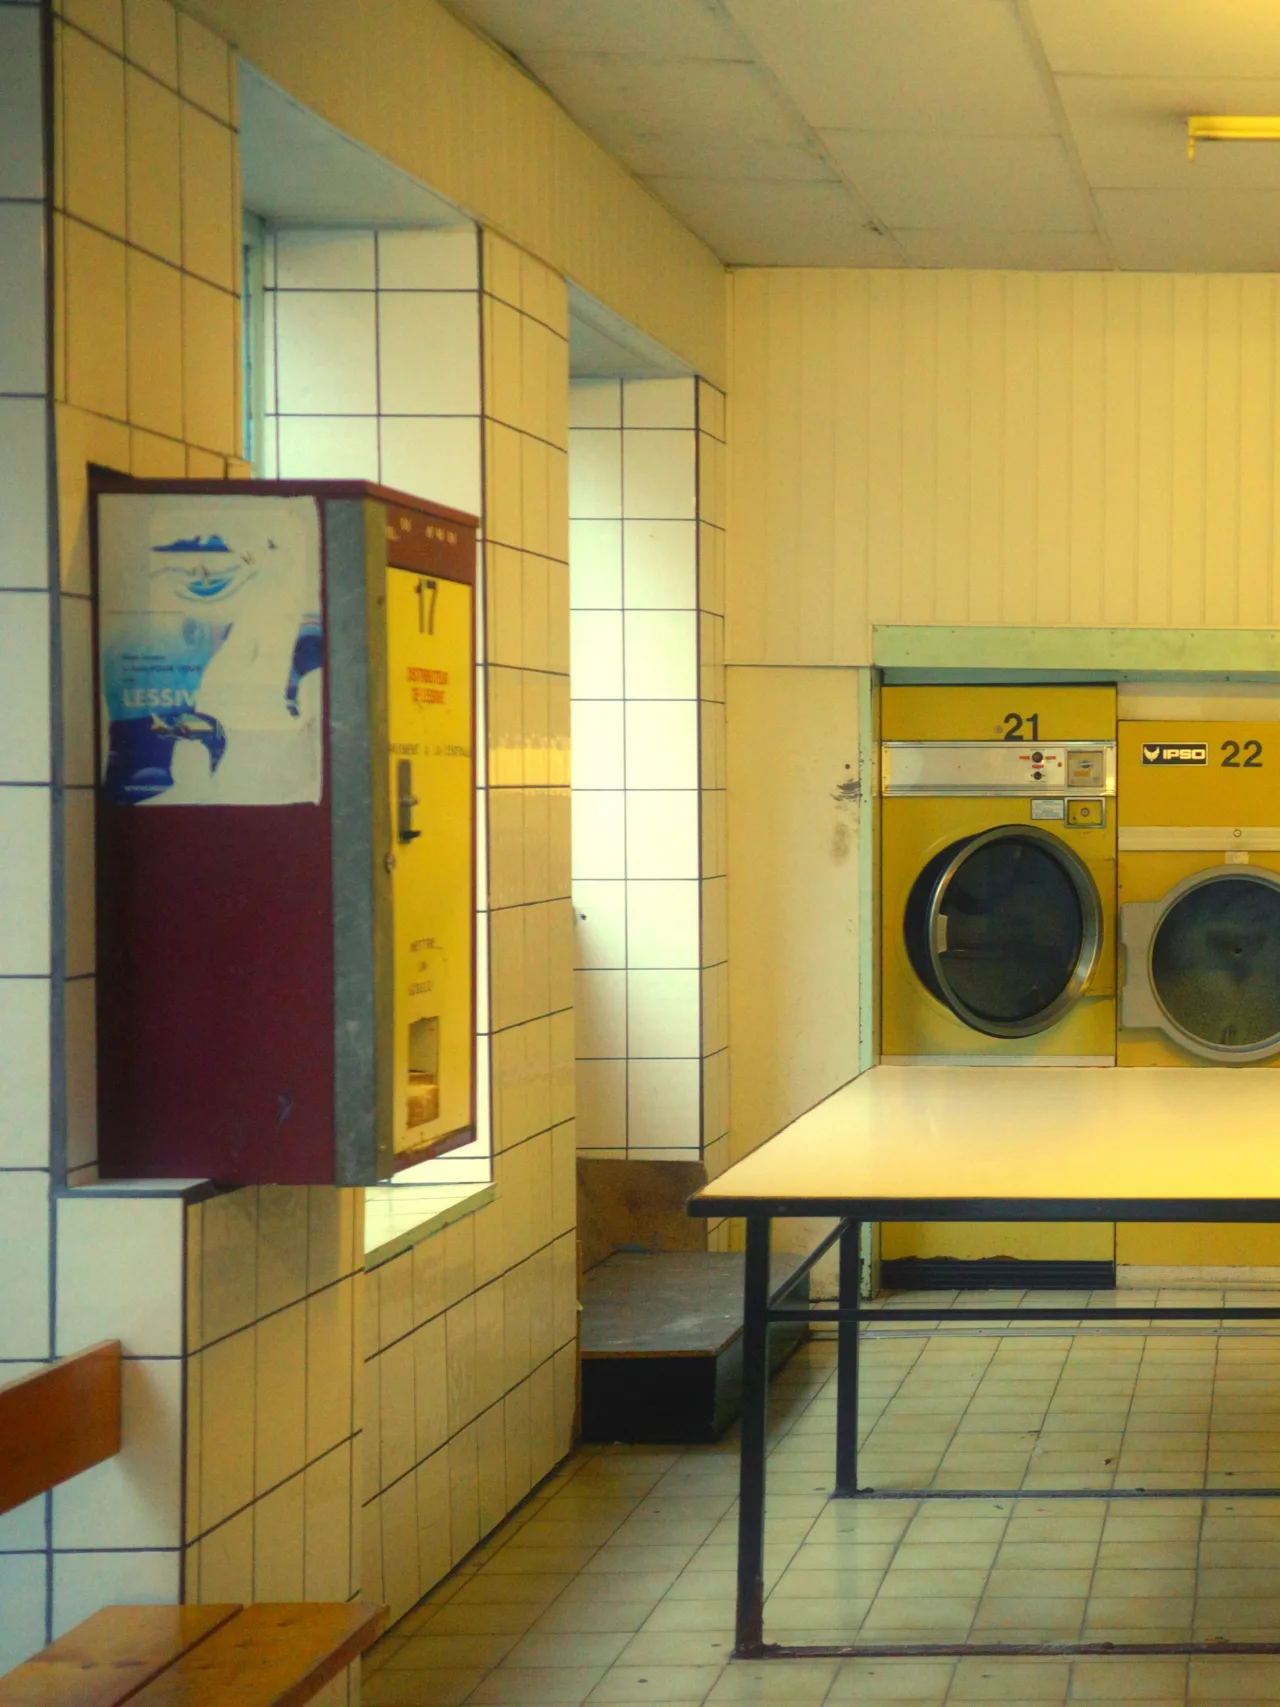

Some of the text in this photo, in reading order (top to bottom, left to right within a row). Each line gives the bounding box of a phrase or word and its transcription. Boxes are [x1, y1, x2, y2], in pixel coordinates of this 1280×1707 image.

[415, 578, 438, 635] 17
[1003, 713, 1039, 741] 21
[1162, 748, 1206, 761] IPSO
[1220, 740, 1263, 768] 22
